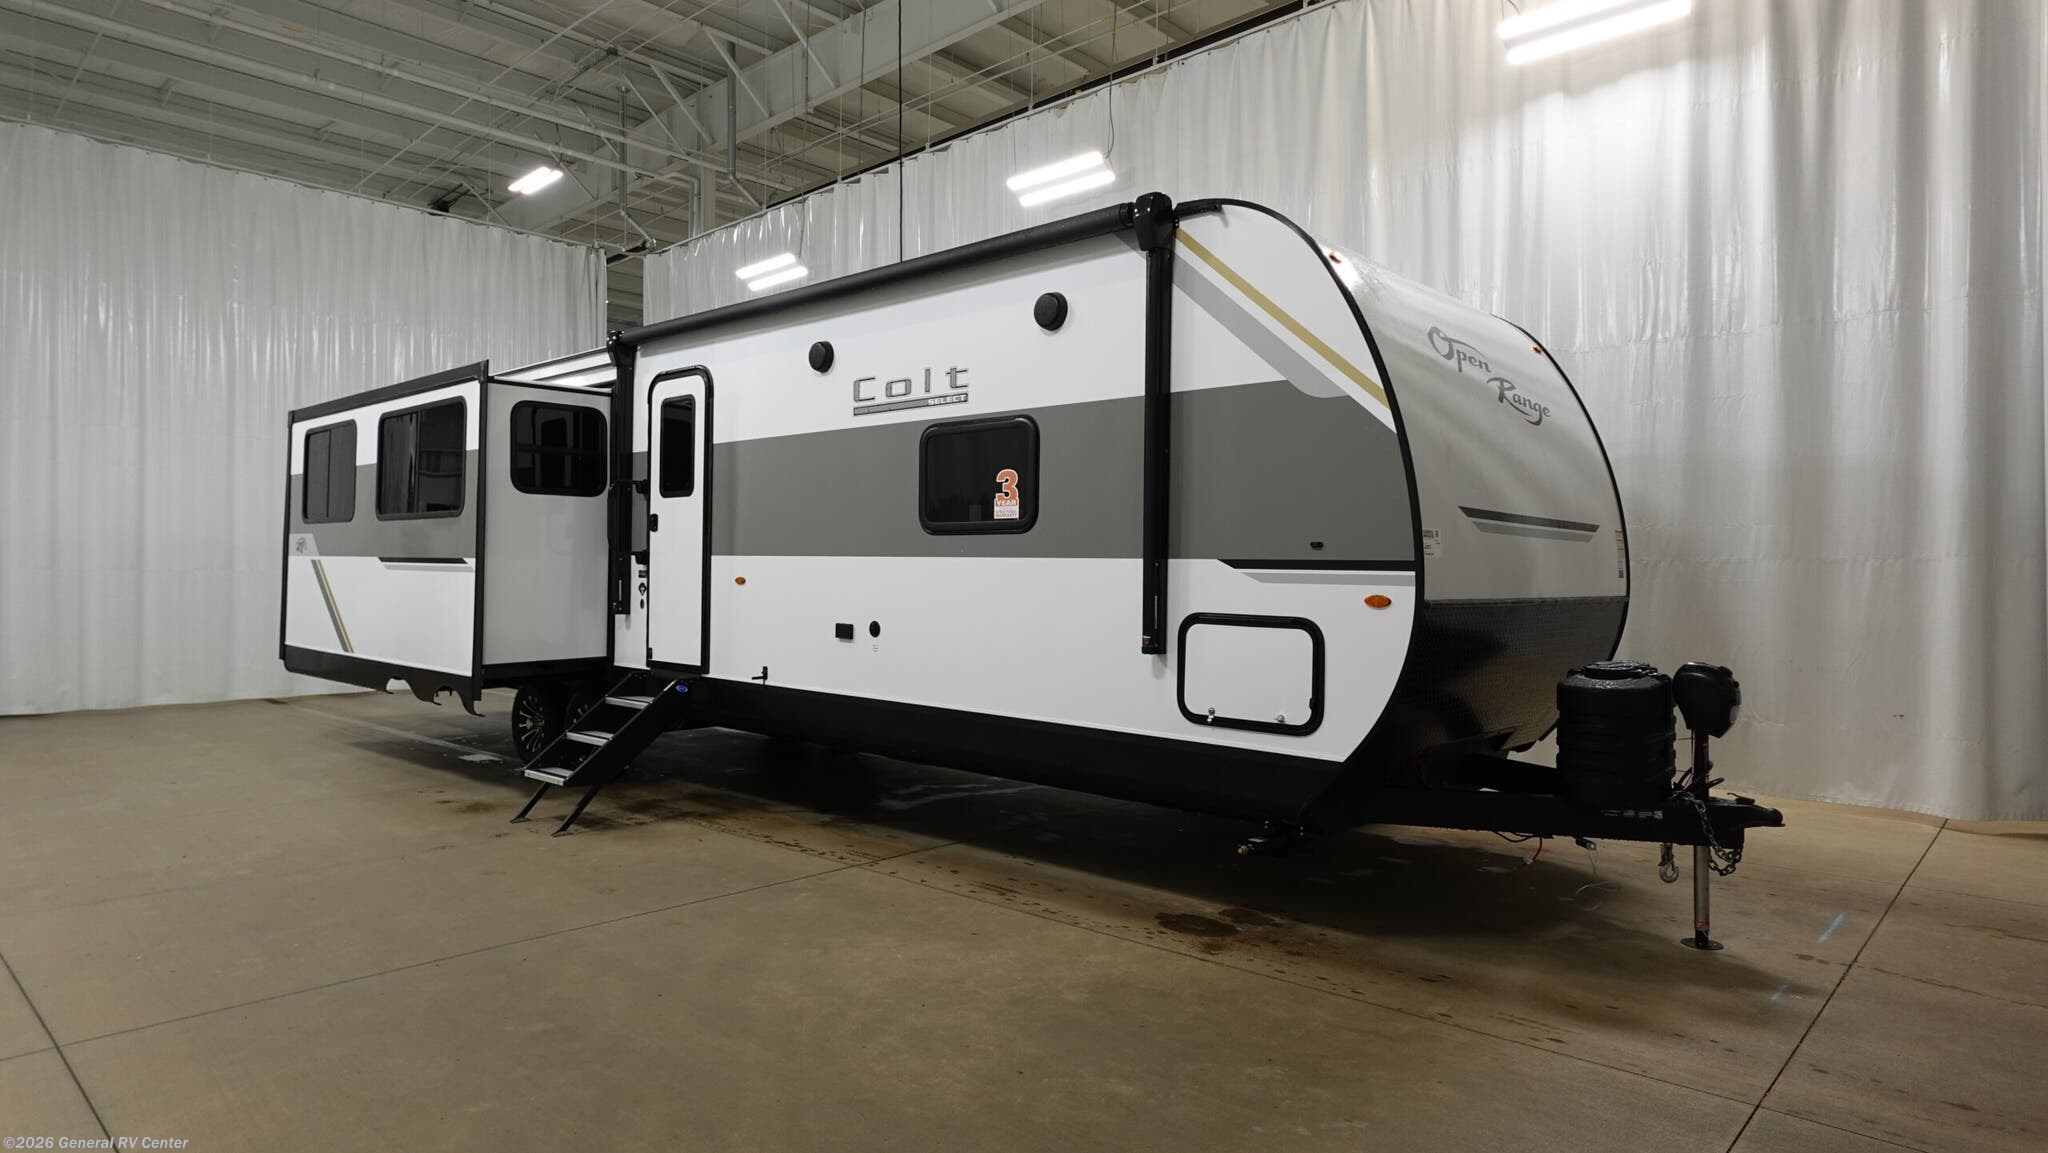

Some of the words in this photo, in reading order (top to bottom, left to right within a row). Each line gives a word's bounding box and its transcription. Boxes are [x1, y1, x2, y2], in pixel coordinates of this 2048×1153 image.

[853, 367, 969, 402] Colt
[1427, 326, 1492, 373] Open
[1486, 377, 1551, 426] Range
[928, 395, 967, 406] SELECT
[995, 468, 1019, 501] 3
